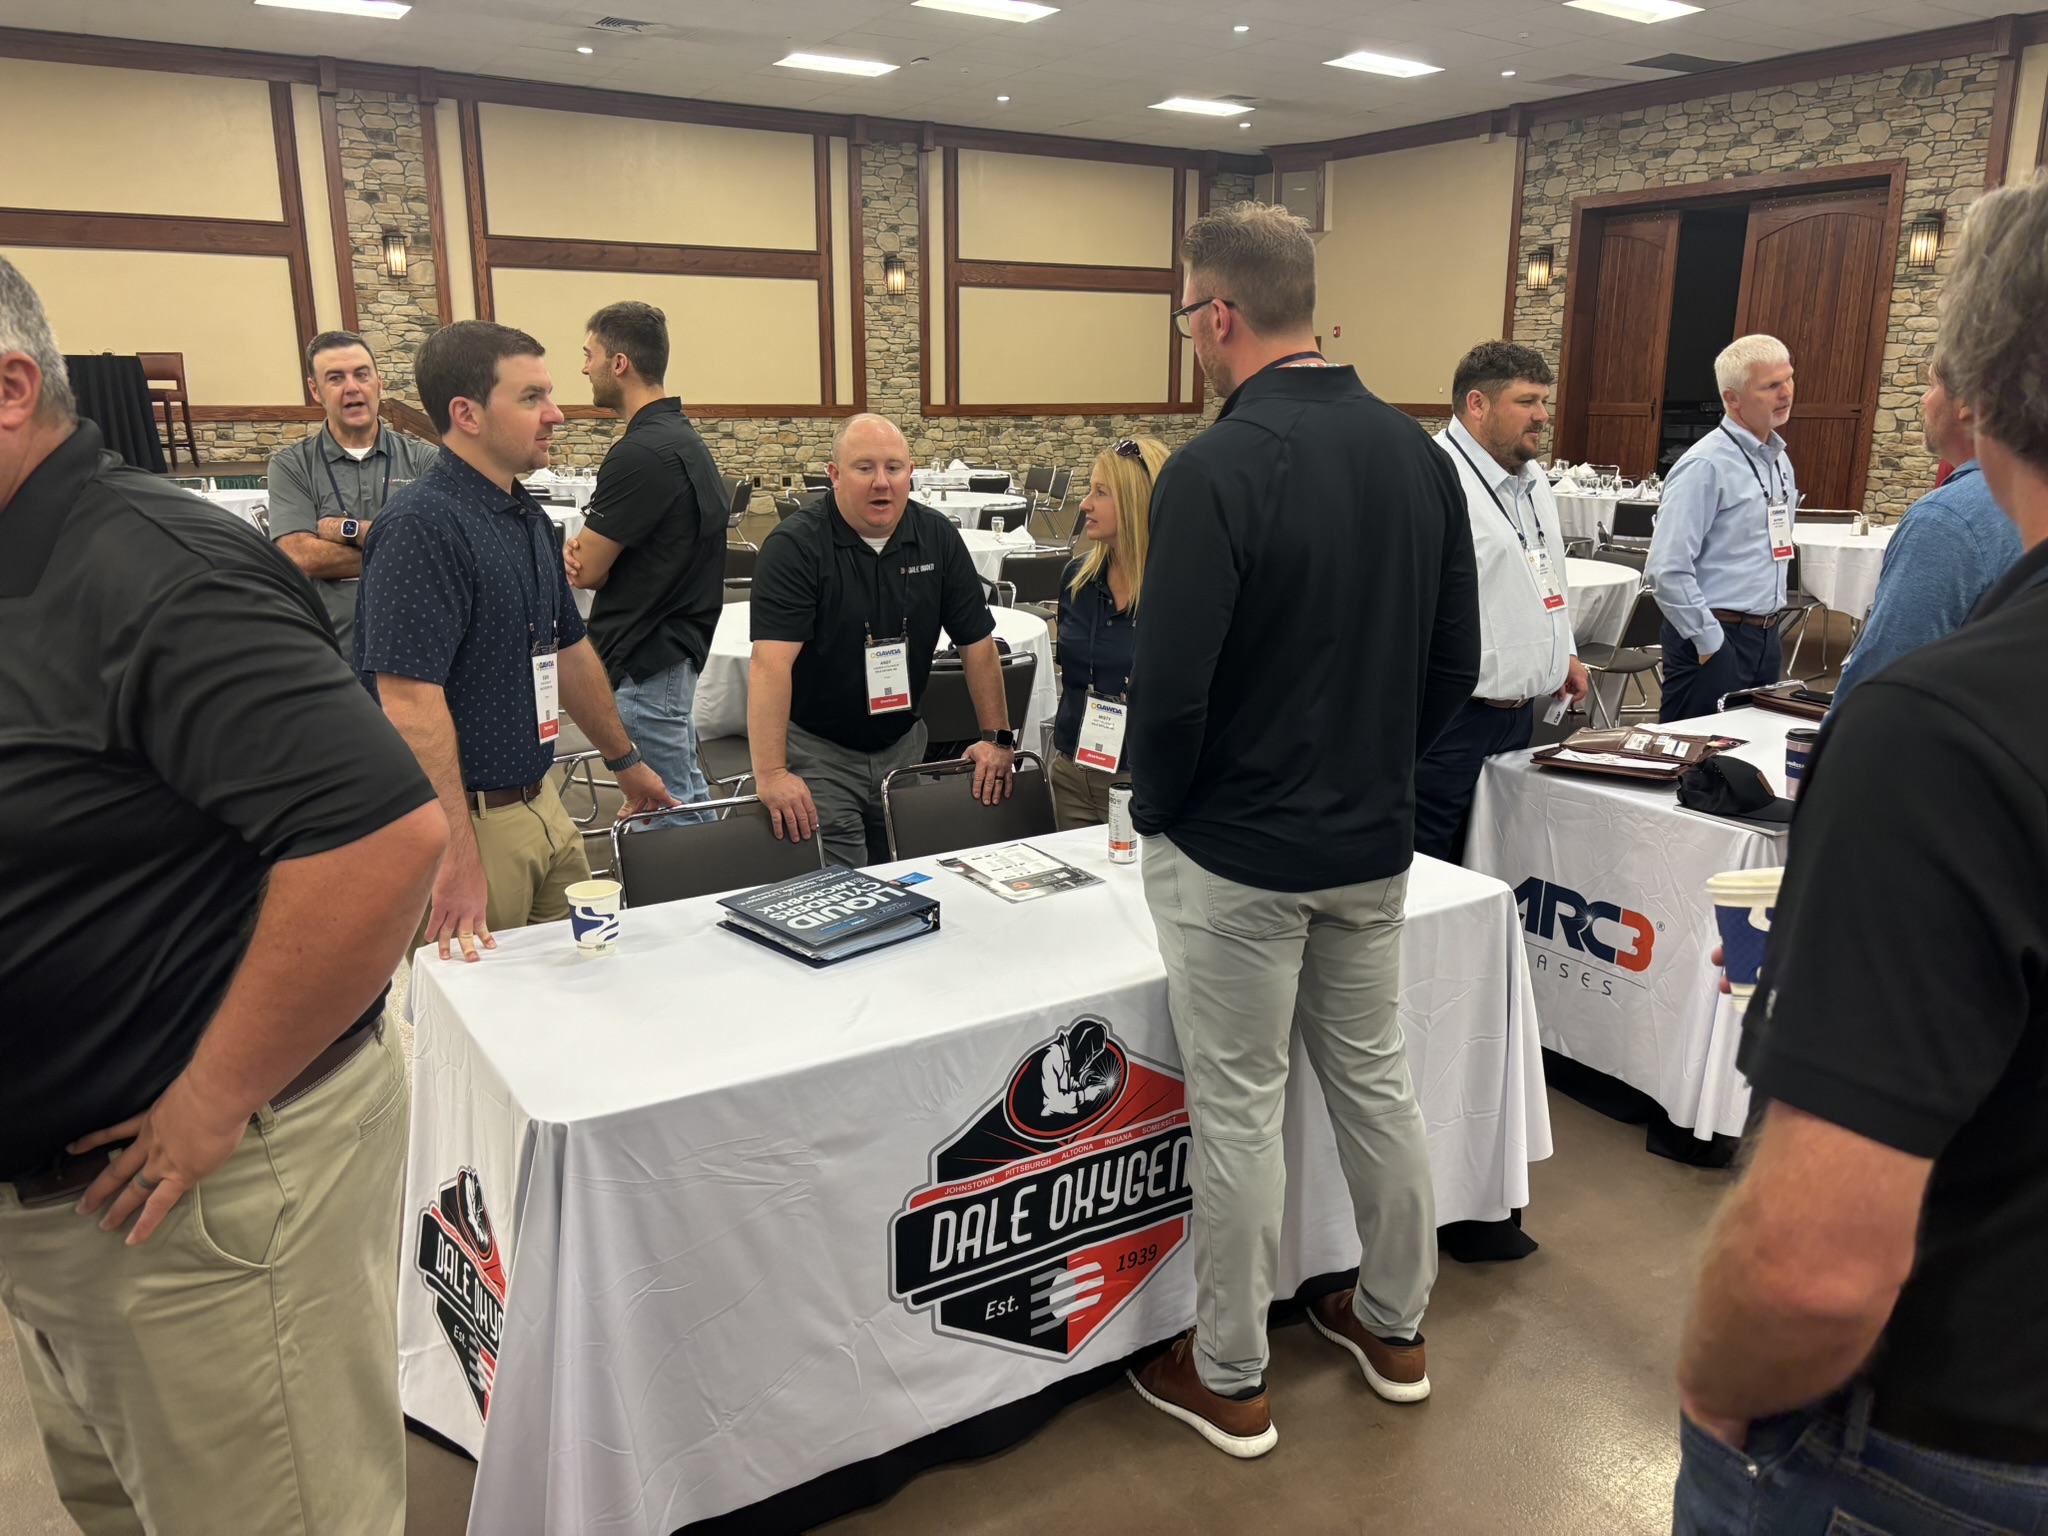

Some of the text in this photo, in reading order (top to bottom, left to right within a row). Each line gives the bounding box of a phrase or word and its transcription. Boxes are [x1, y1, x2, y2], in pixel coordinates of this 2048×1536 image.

[755, 879, 857, 914] MICROBULK
[768, 881, 882, 921] CYLINDERS
[786, 886, 907, 930] LIQUID
[1513, 876, 1655, 973] ARC3
[1536, 953, 1613, 996] ASES
[944, 1116, 1177, 1195] JOHNSTOWN PITTSBURGH ALTOONA INDIANA SOMERSET
[929, 1135, 1193, 1273] DALE OXYGEN
[435, 1231, 472, 1304] DALE
[984, 1243, 1158, 1321] Est. 1939
[453, 1325, 467, 1348] Est.
